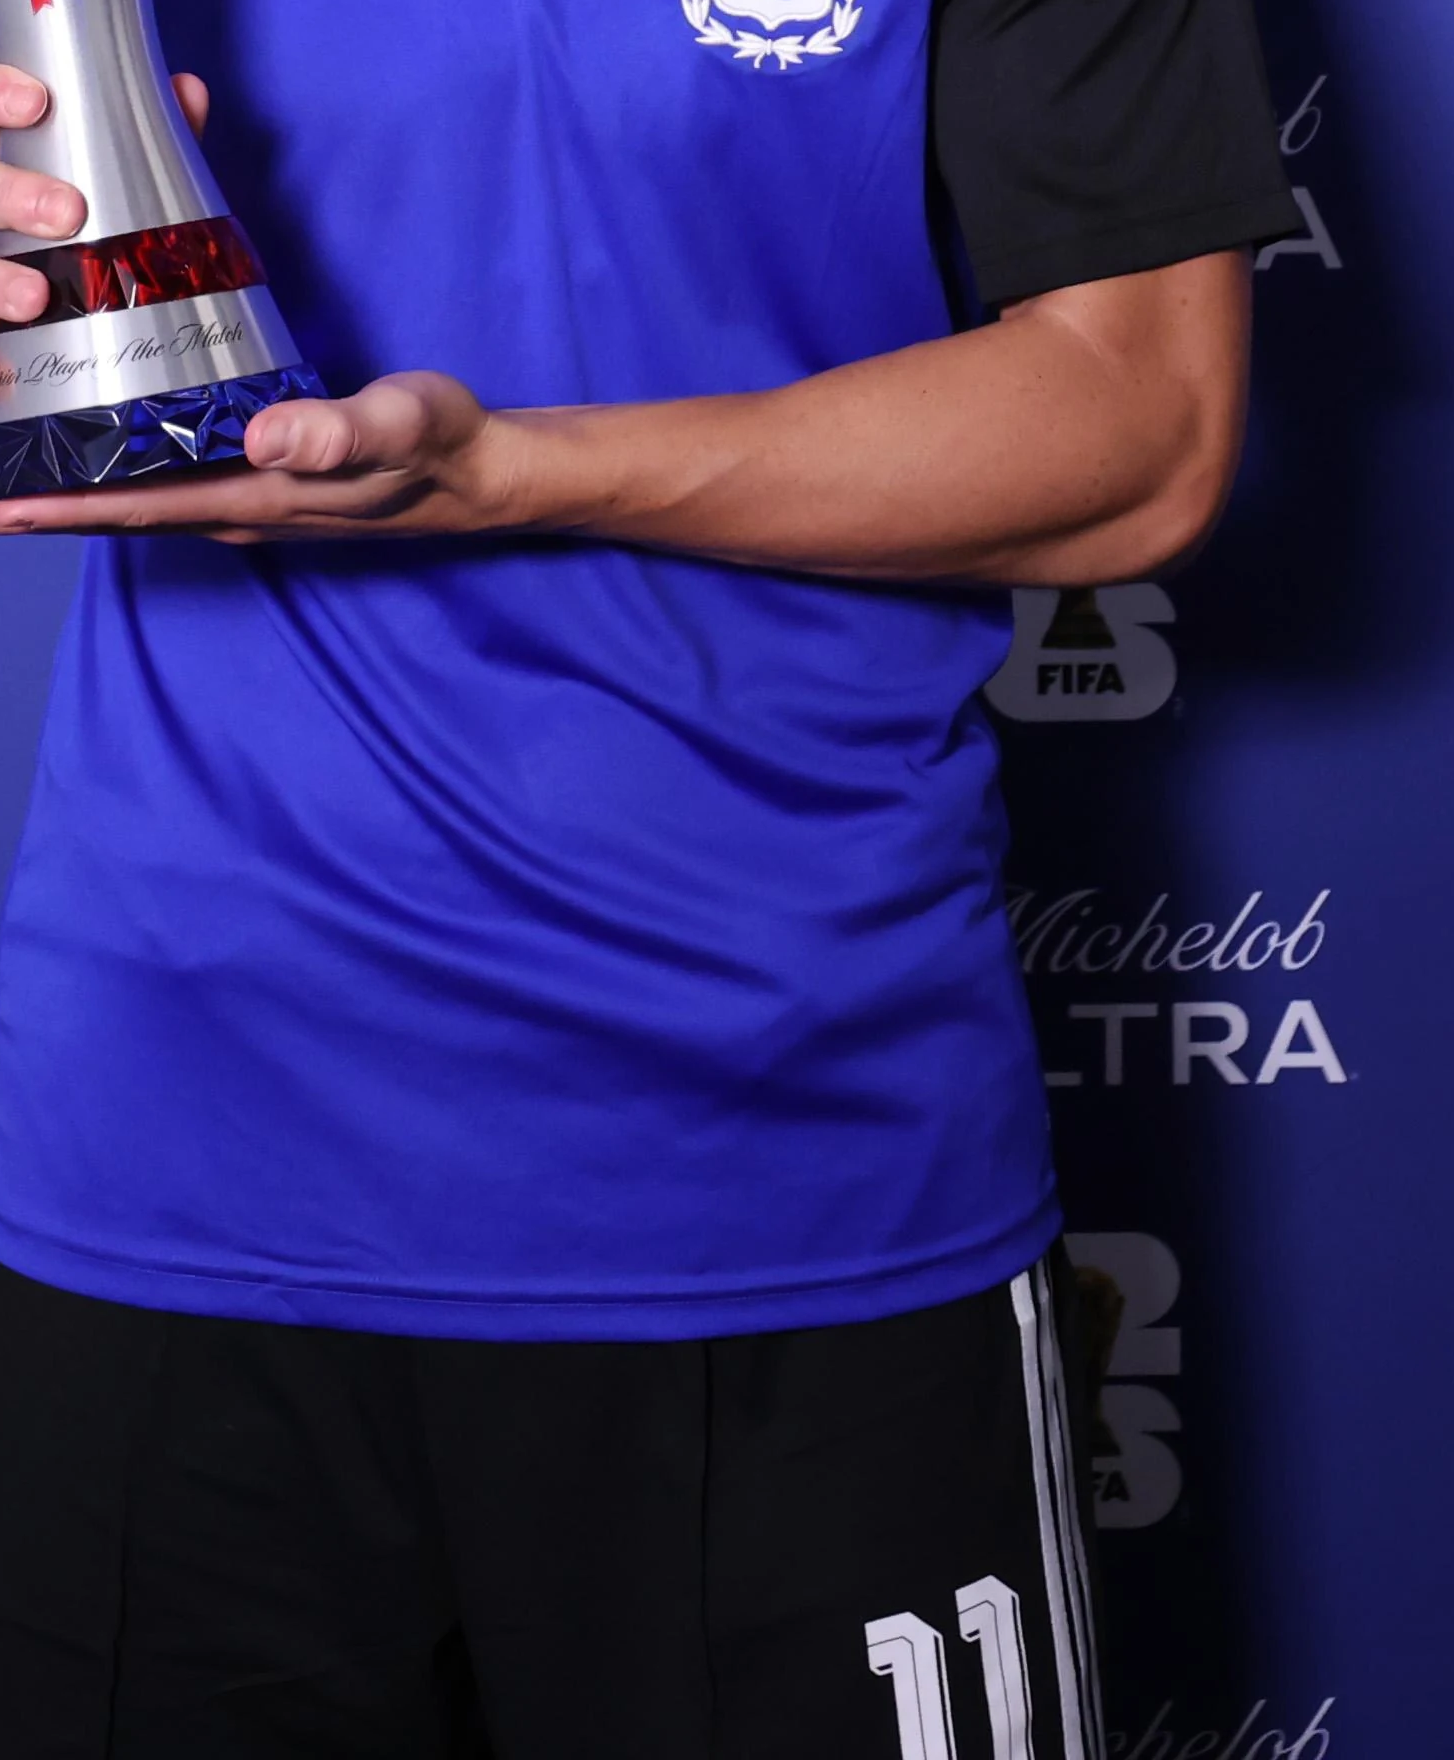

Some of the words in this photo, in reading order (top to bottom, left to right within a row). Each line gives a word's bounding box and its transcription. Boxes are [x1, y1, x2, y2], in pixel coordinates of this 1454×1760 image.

[23, 352, 99, 388] Player
[130, 337, 167, 363] the
[169, 321, 244, 357] Match
[1037, 663, 1125, 695] FIFA
[1044, 1000, 1347, 1086] TRA
